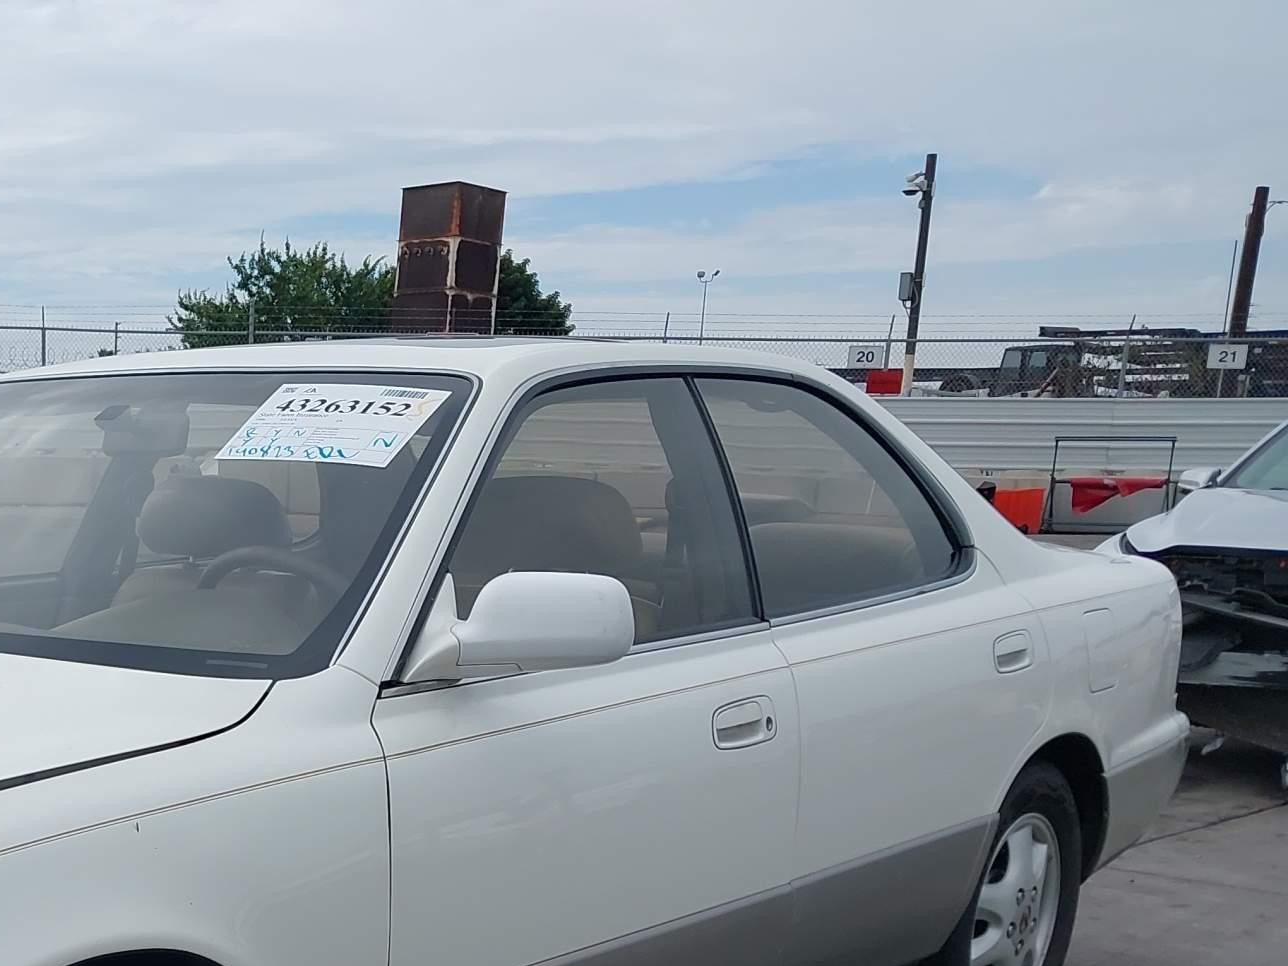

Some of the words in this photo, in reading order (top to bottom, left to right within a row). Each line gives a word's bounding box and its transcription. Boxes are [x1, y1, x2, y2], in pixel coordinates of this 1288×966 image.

[855, 350, 875, 363] 20
[1218, 350, 1237, 363] 21
[275, 398, 412, 417] 43263152
[373, 433, 399, 448] N
